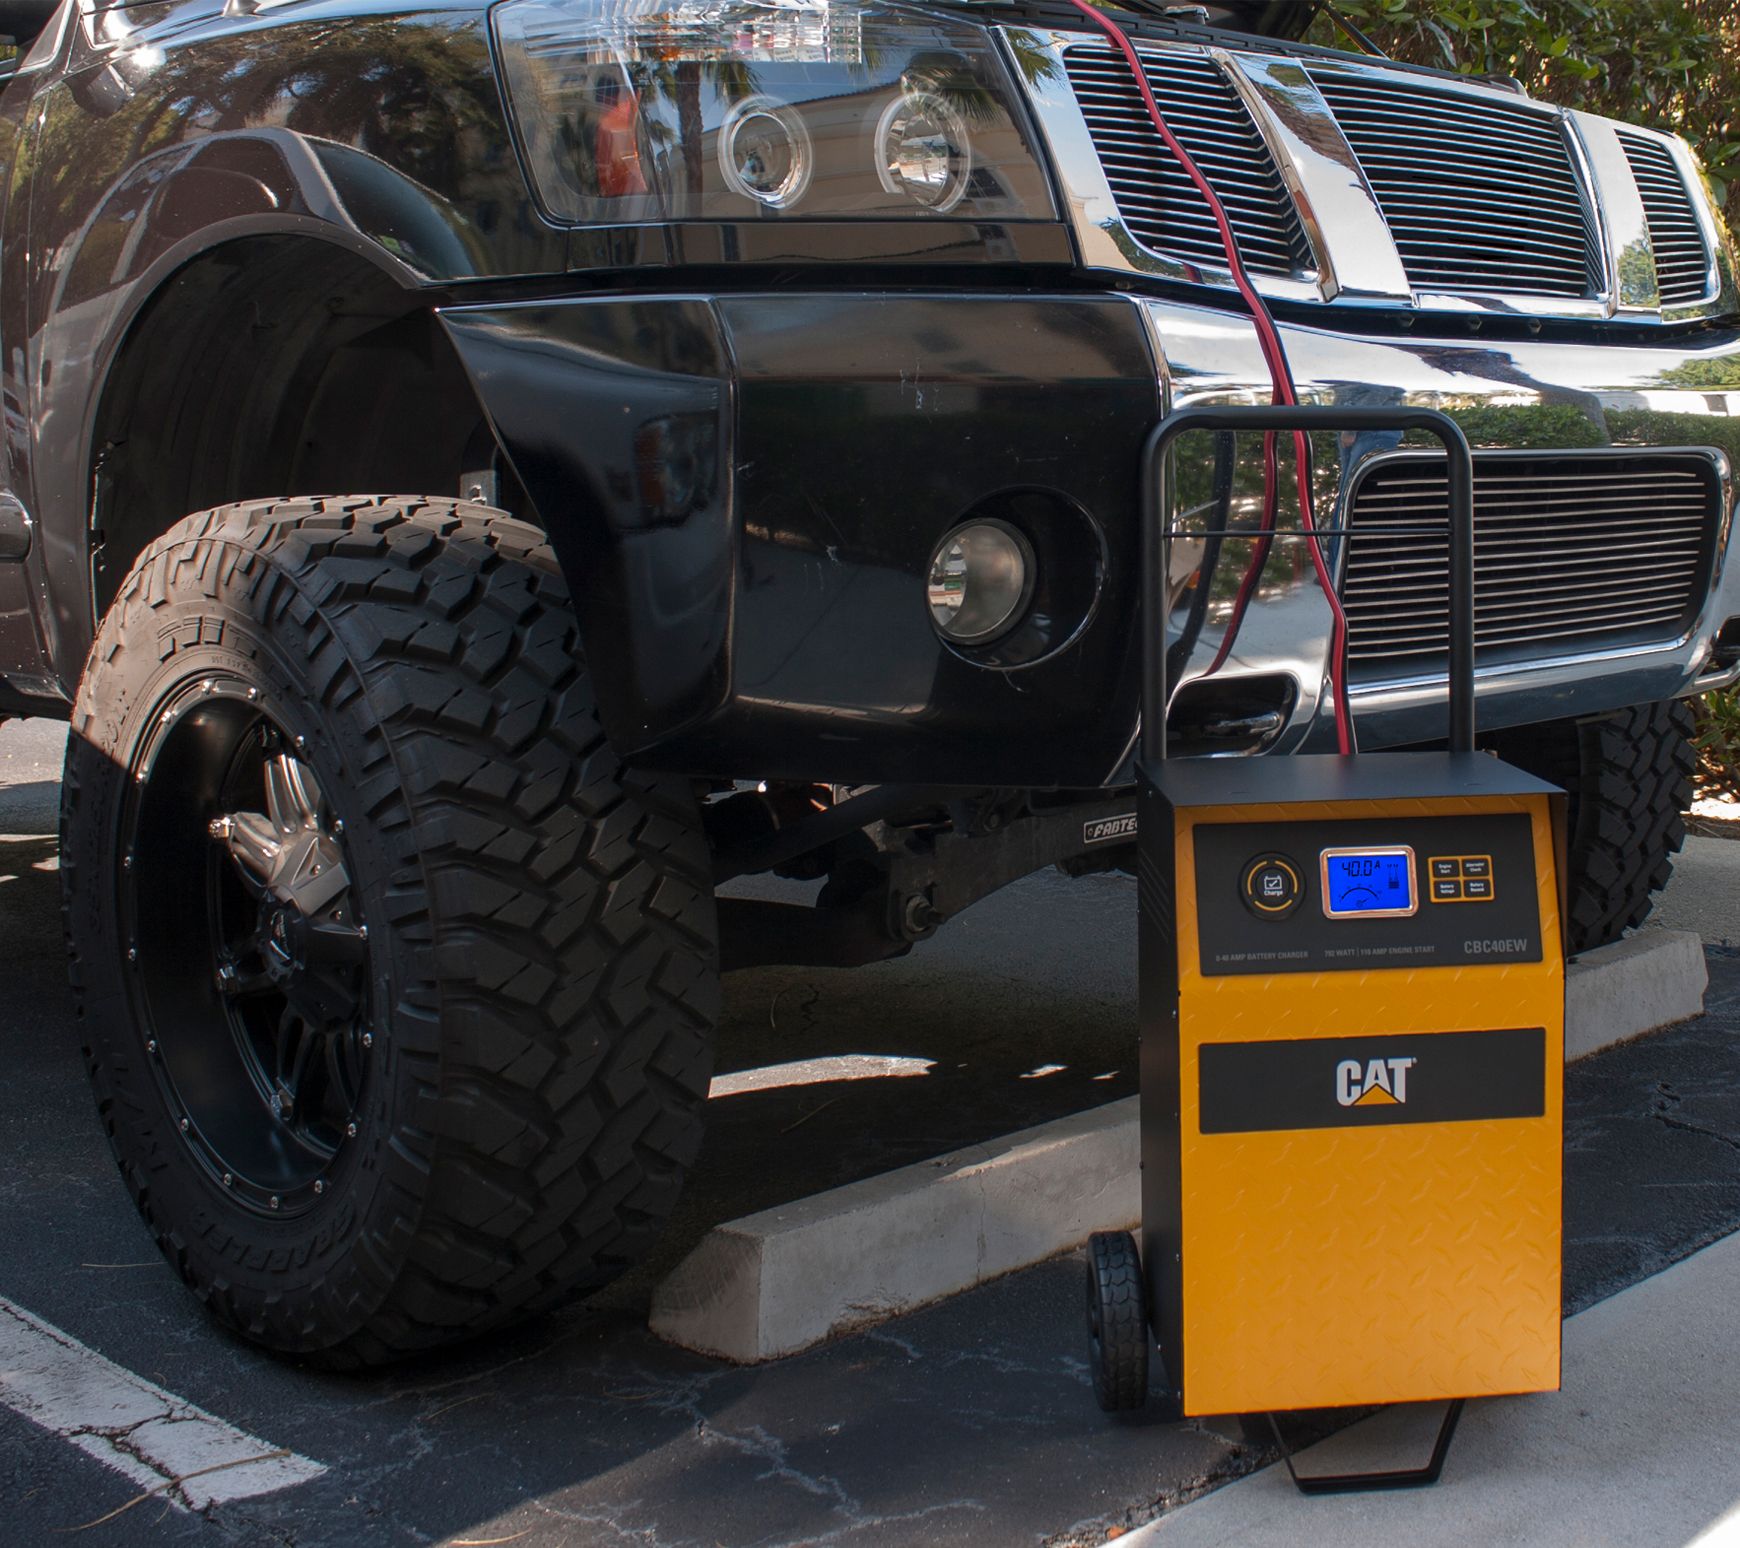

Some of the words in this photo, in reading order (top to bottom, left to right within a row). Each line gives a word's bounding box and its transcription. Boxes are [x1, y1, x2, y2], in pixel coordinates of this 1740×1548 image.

[1464, 938, 1528, 954] CBC40EW
[1230, 952, 1246, 961] AMP
[1247, 951, 1277, 961] BATTERY
[1278, 950, 1309, 960] CHARGER
[1336, 1057, 1412, 1107] CAT
